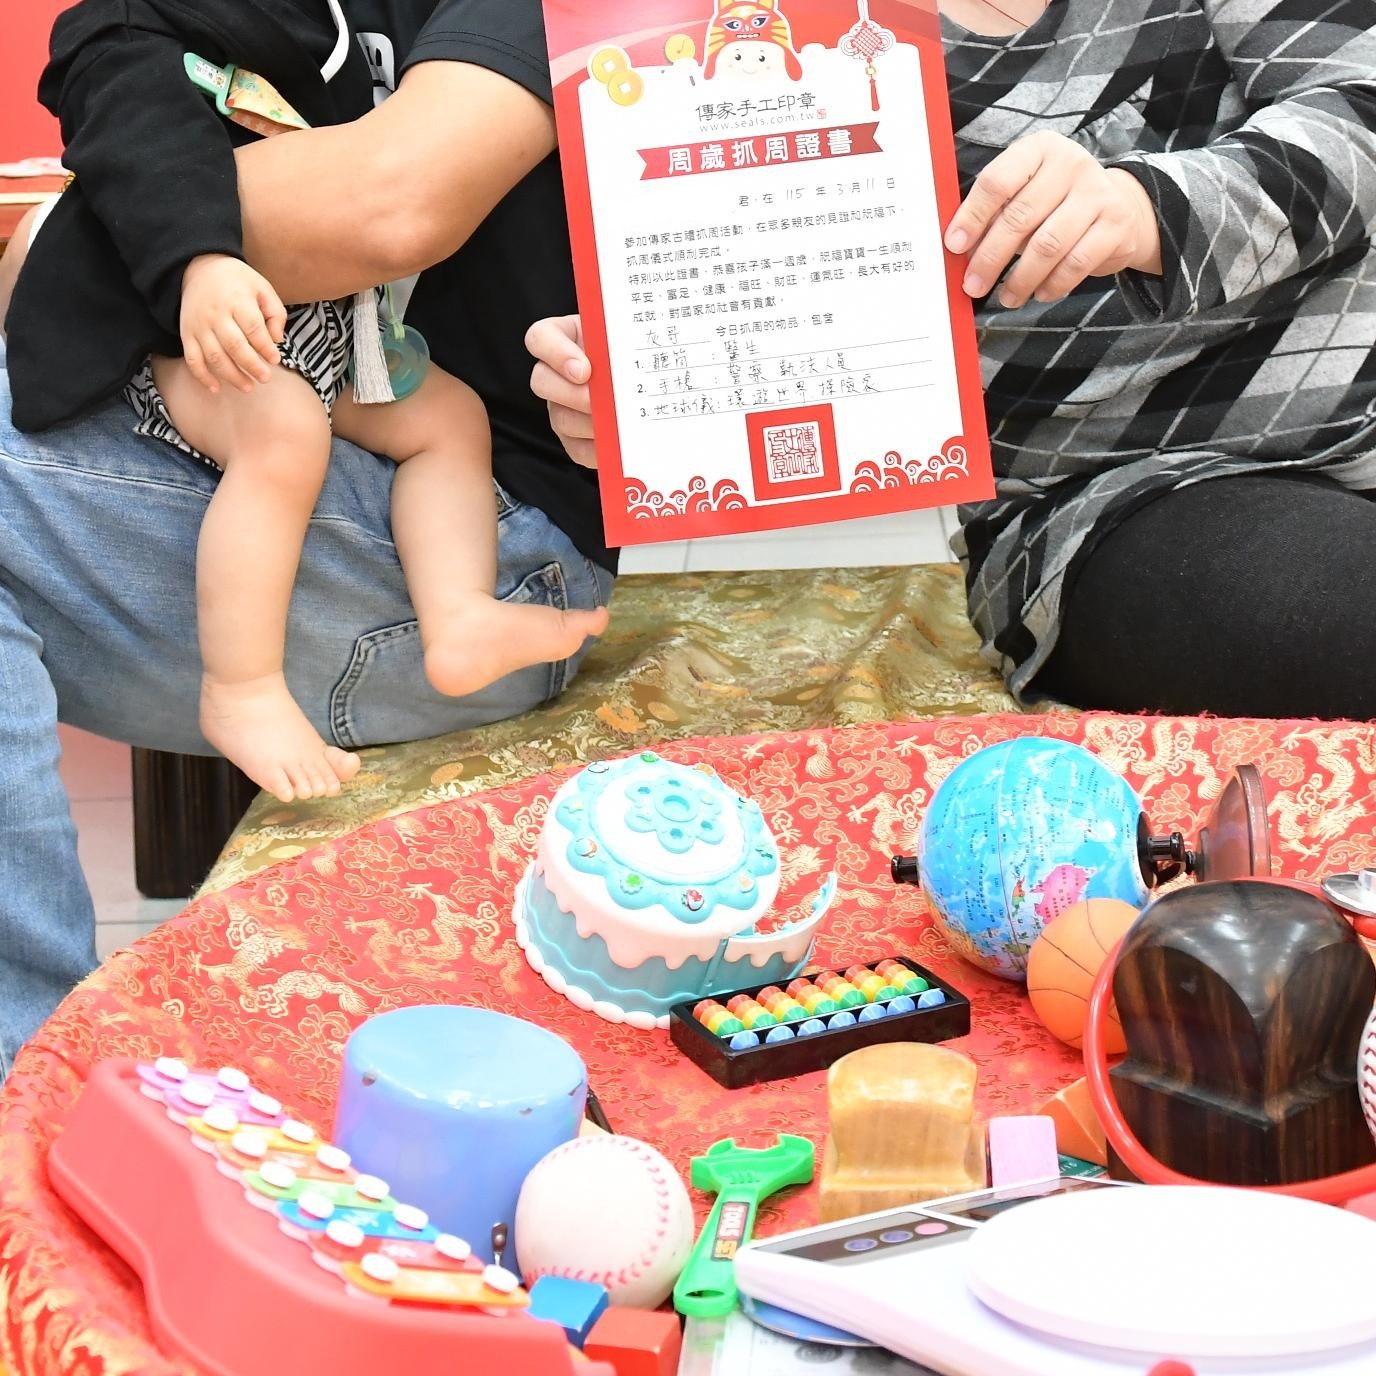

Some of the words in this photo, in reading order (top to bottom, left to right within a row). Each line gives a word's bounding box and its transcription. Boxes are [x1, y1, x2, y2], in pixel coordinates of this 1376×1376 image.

[695, 92, 817, 122] 傳家手工印章
[699, 113, 815, 132] www.seals.com.tw
[668, 128, 853, 174] 周歲抓周證書
[837, 184, 844, 195] 3
[886, 178, 896, 190] 日
[718, 1204, 746, 1237] TOOLS
